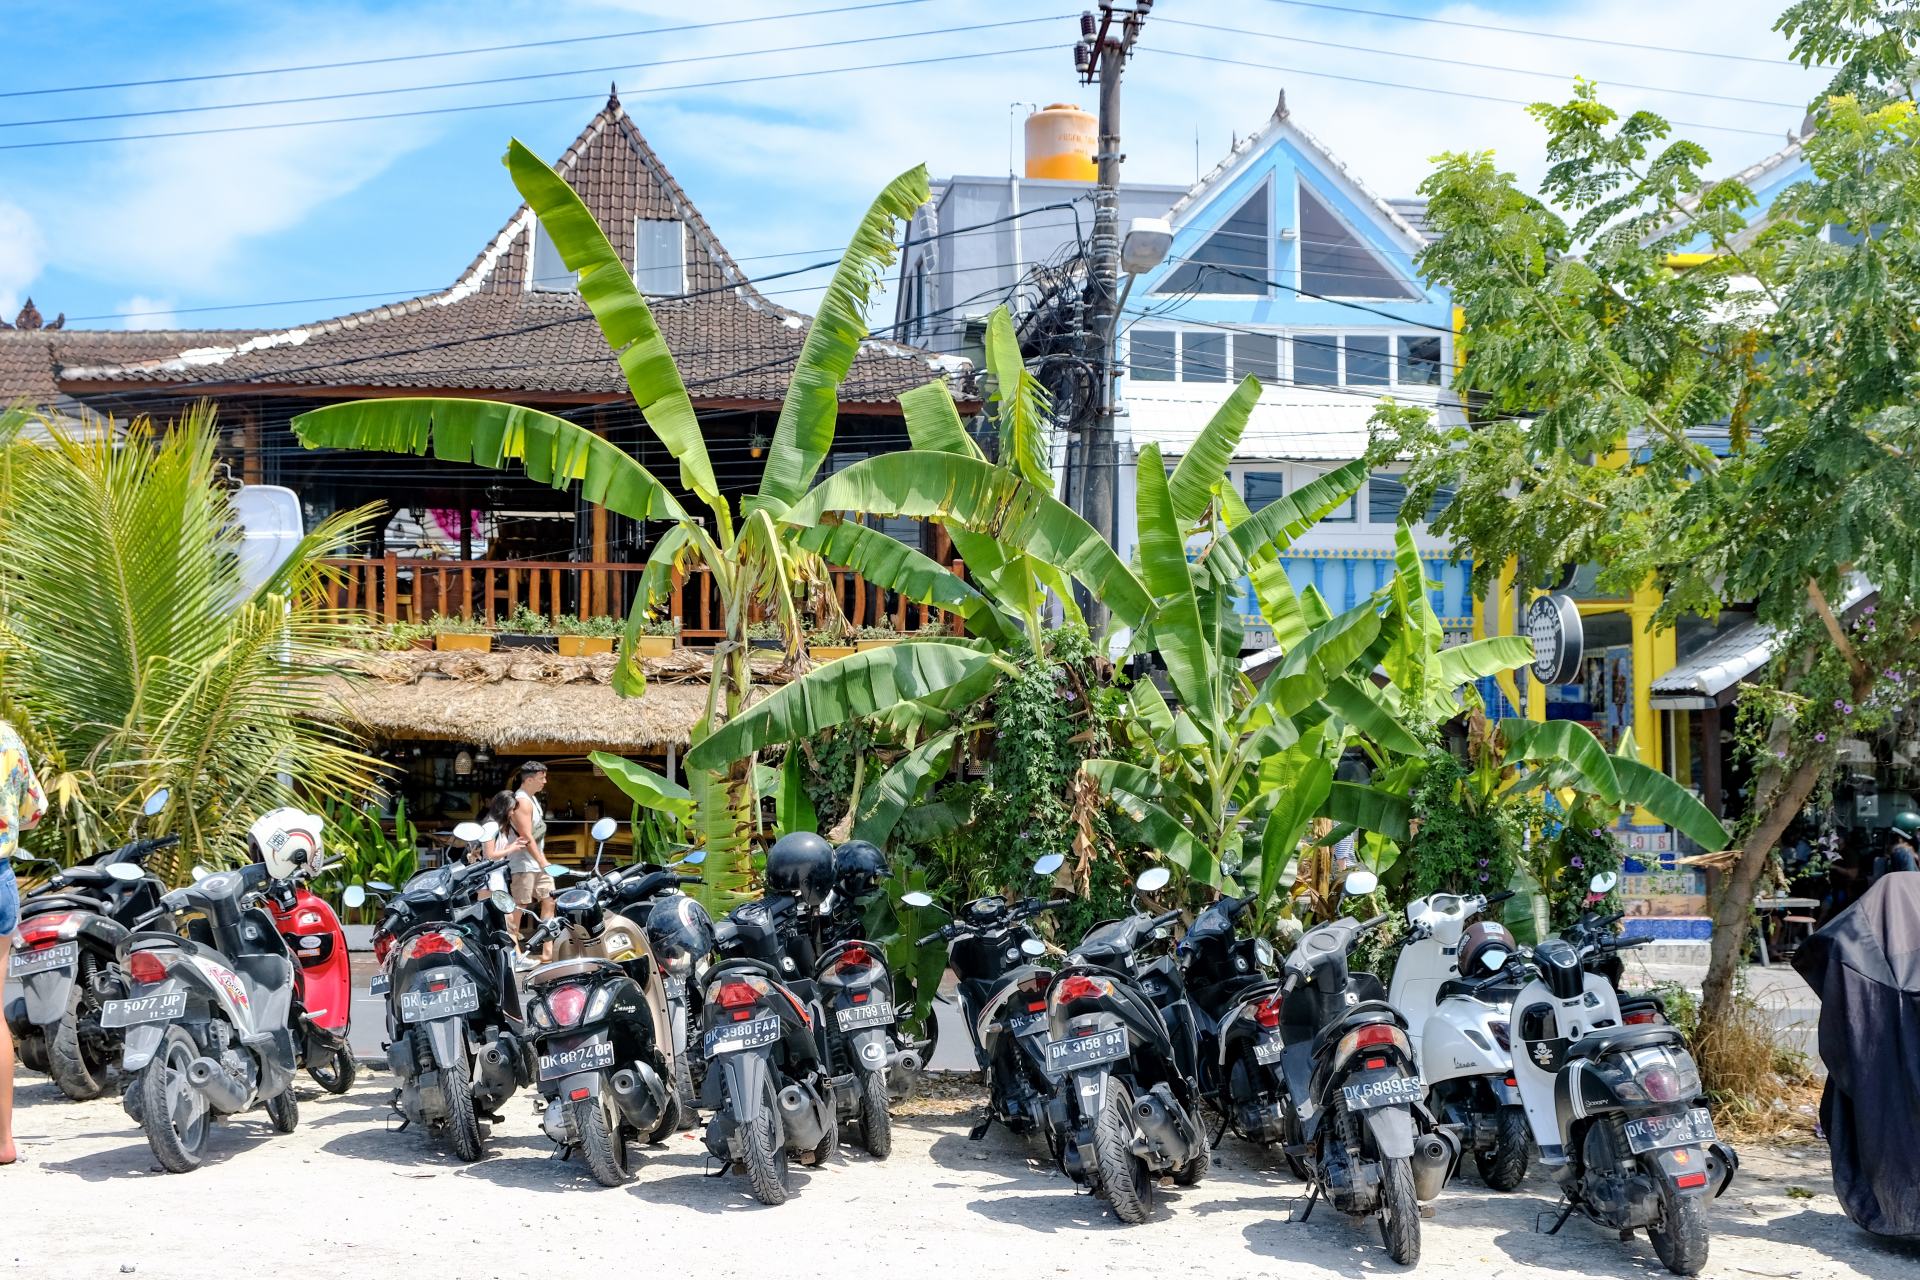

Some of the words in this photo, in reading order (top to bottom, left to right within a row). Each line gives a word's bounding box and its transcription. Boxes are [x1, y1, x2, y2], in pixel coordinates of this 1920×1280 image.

[372, 974, 384, 986] DK
[107, 1002, 118, 1014] P
[124, 998, 157, 1012] 5077
[403, 994, 418, 1008] DK
[421, 992, 449, 1006] 6217
[453, 986, 475, 1000] AAL
[839, 1010, 853, 1022] DK
[854, 1006, 878, 1019] 7799
[1010, 1017, 1025, 1028] DK
[706, 1030, 718, 1045] DK
[722, 1025, 752, 1038] 3980
[755, 1019, 777, 1034] FAA
[1053, 1044, 1068, 1059] DK
[1073, 1038, 1101, 1053] 3158
[541, 1055, 558, 1069] DK
[1343, 1085, 1361, 1100] DK
[1362, 1080, 1402, 1097] 6889
[1402, 1078, 1420, 1093] ES
[1628, 1121, 1647, 1138] DK
[1685, 1110, 1709, 1126] AAF
